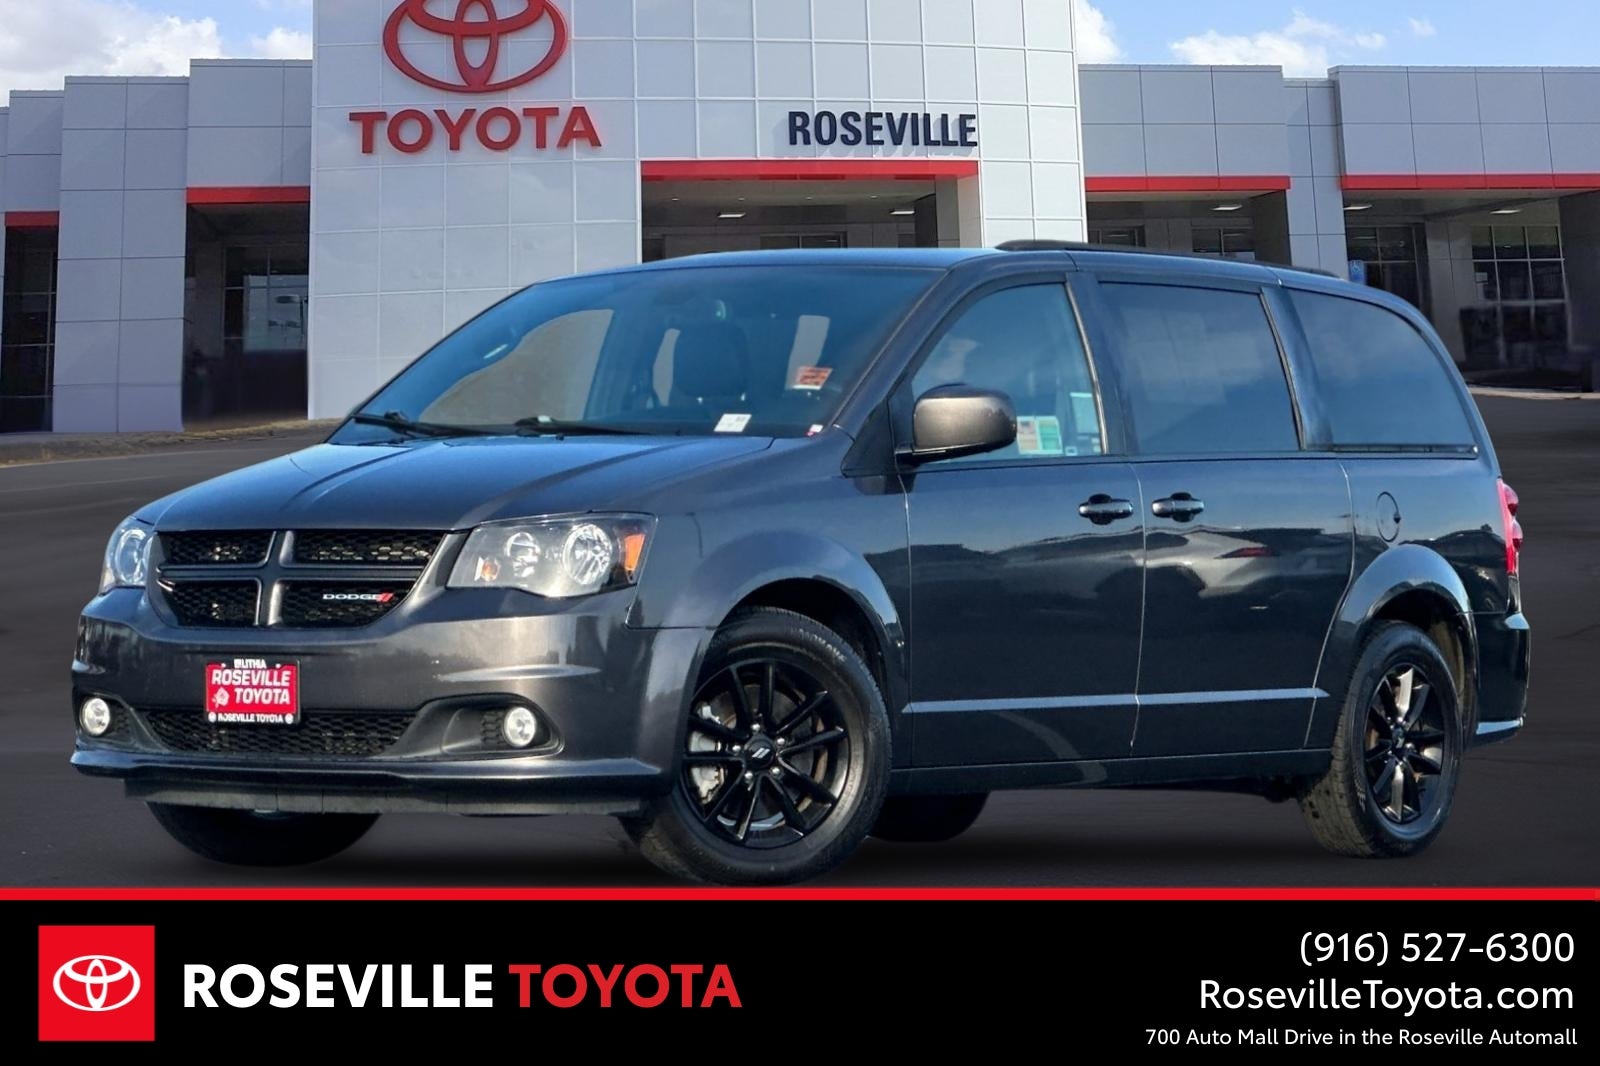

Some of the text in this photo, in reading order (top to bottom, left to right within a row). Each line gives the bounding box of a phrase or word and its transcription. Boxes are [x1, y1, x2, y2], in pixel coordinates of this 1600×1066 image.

[349, 106, 602, 154] TOYOTA
[788, 110, 978, 147] ROSEVILLE
[322, 593, 381, 601] DODGE
[211, 669, 292, 686] ROSEVILLE
[234, 687, 291, 705] TOYOTA
[217, 712, 284, 723] ROSEVILLE TOYOTA
